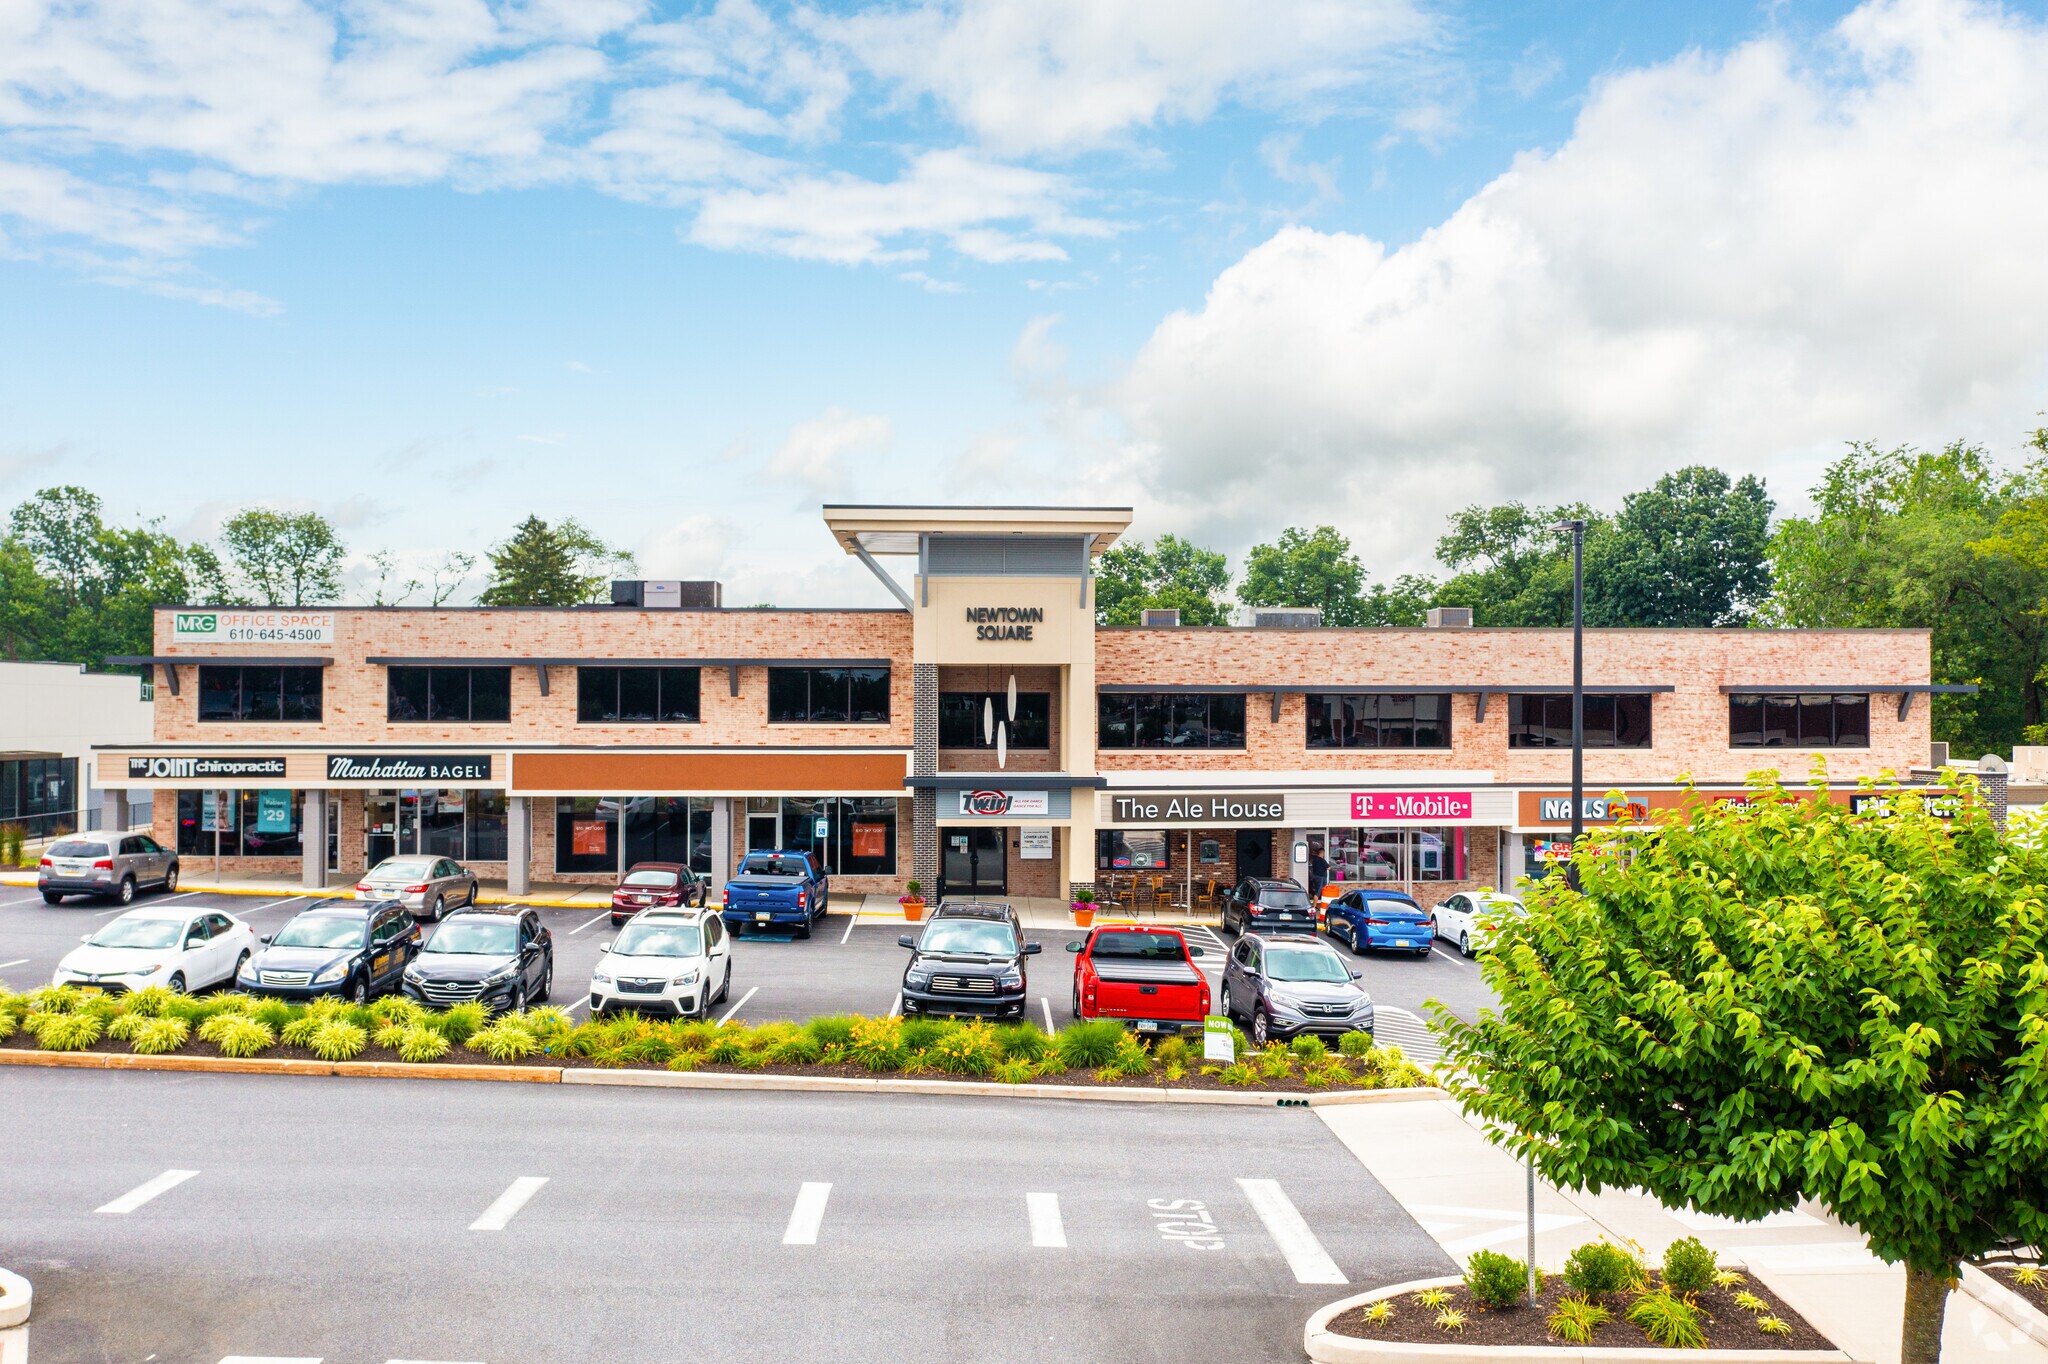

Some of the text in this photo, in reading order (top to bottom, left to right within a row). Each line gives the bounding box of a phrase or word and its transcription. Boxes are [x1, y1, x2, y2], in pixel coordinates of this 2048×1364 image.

[221, 615, 331, 626] OFFICE SPACE
[966, 607, 1043, 622] NEWTOWN
[178, 616, 215, 631] MRG
[229, 629, 321, 640] 610-645-4500
[976, 625, 1033, 640] SQUARE
[129, 758, 284, 777] THE JOINT chiropractic
[330, 757, 482, 778] Manhattan BAGEL
[263, 809, 286, 821] $29
[1116, 797, 1282, 818] The Ale House
[1545, 800, 1604, 818] NALS
[1208, 1019, 1227, 1029] NOW
[1147, 1198, 1226, 1250] STOP
